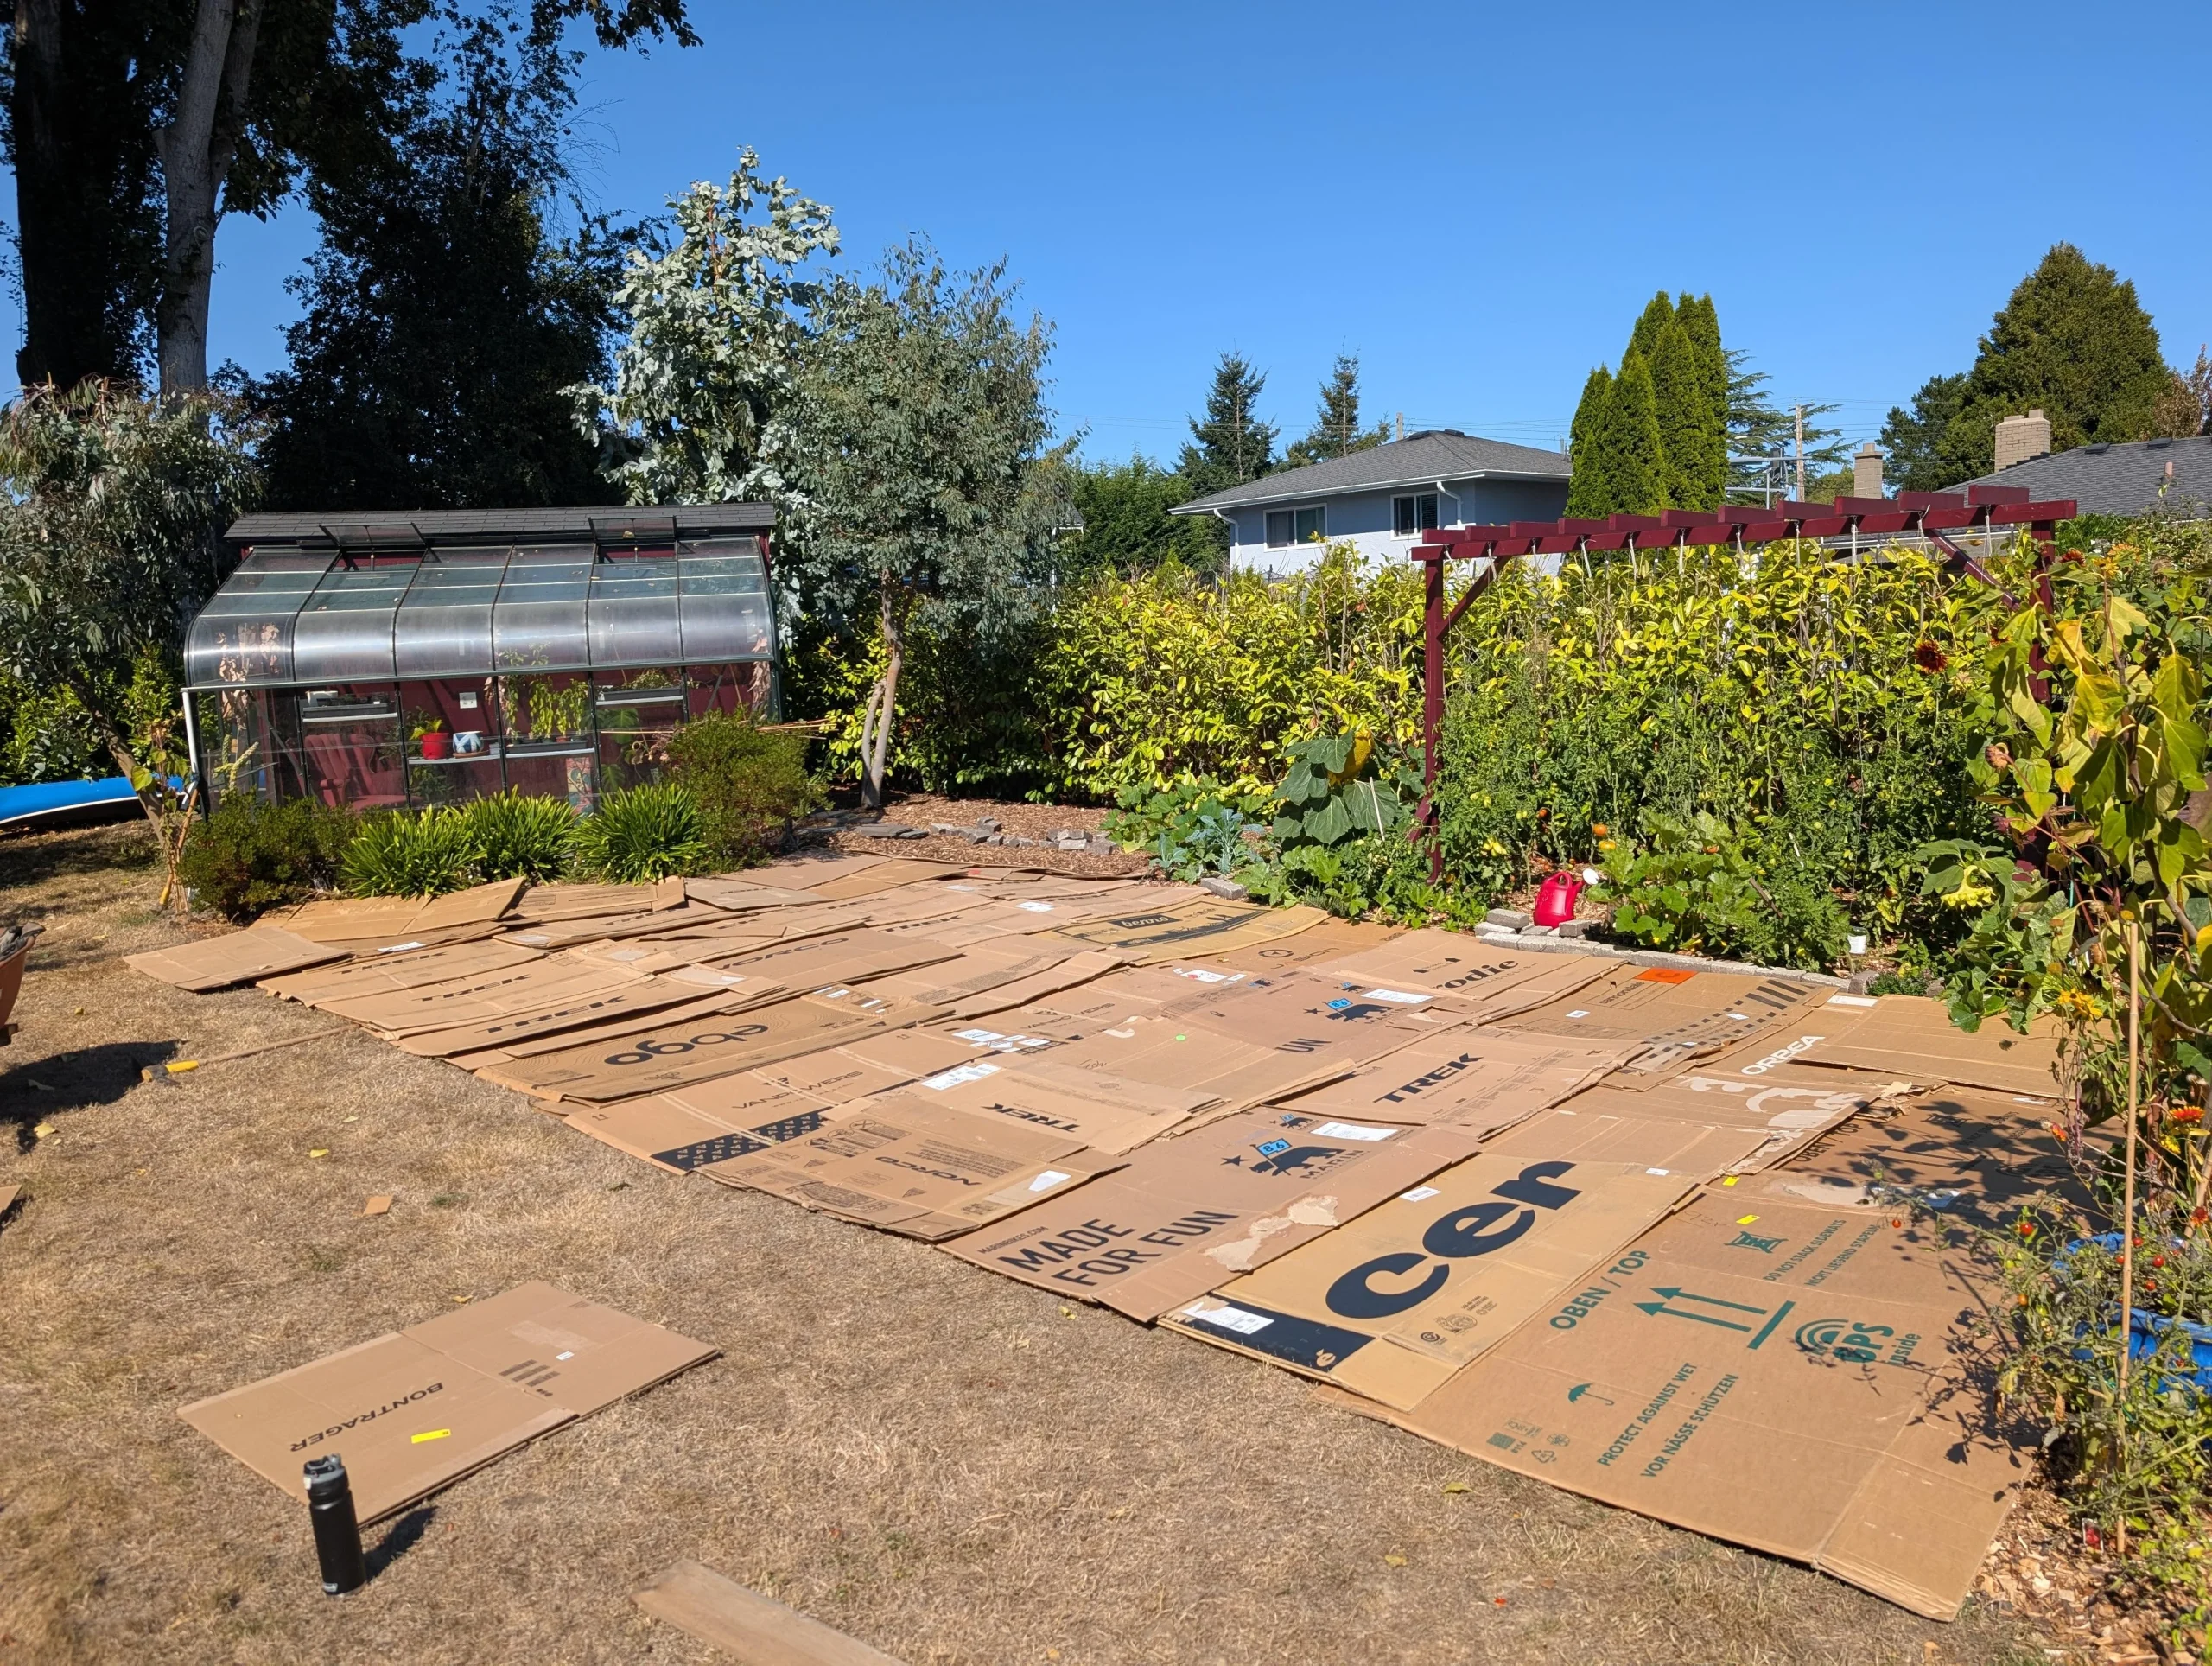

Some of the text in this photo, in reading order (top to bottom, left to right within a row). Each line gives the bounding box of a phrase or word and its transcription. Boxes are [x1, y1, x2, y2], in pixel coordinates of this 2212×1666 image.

[877, 914, 965, 932] TREK
[1121, 913, 1170, 928] benno
[411, 974, 531, 1002] TREK
[474, 995, 629, 1034] TREK
[1740, 1036, 1826, 1075] ORBEA
[1372, 1052, 1484, 1103] TREK
[982, 1103, 1080, 1134] TREK
[1262, 1141, 1285, 1153] 86
[1299, 1149, 1365, 1180] MARIN
[875, 1155, 982, 1187] NORCO
[996, 1218, 1136, 1273] MADE
[1051, 1210, 1240, 1287] FOR FUN
[1325, 1161, 1582, 1319] cer
[1763, 1219, 1847, 1281] DO NOT STACK SIDEWAYS
[1804, 1270, 1832, 1287] NICHT
[1824, 1248, 1857, 1271] LIEGEND
[1549, 1287, 1611, 1329] OBEN
[1608, 1250, 1651, 1275] TOP
[1885, 1333, 1922, 1366] inside
[289, 1382, 445, 1454] BONTRAGER
[1597, 1363, 1698, 1466] PROTECT AGAINST WET
[1640, 1373, 1739, 1478] VOR NÄSSE SCHÜTZEN
